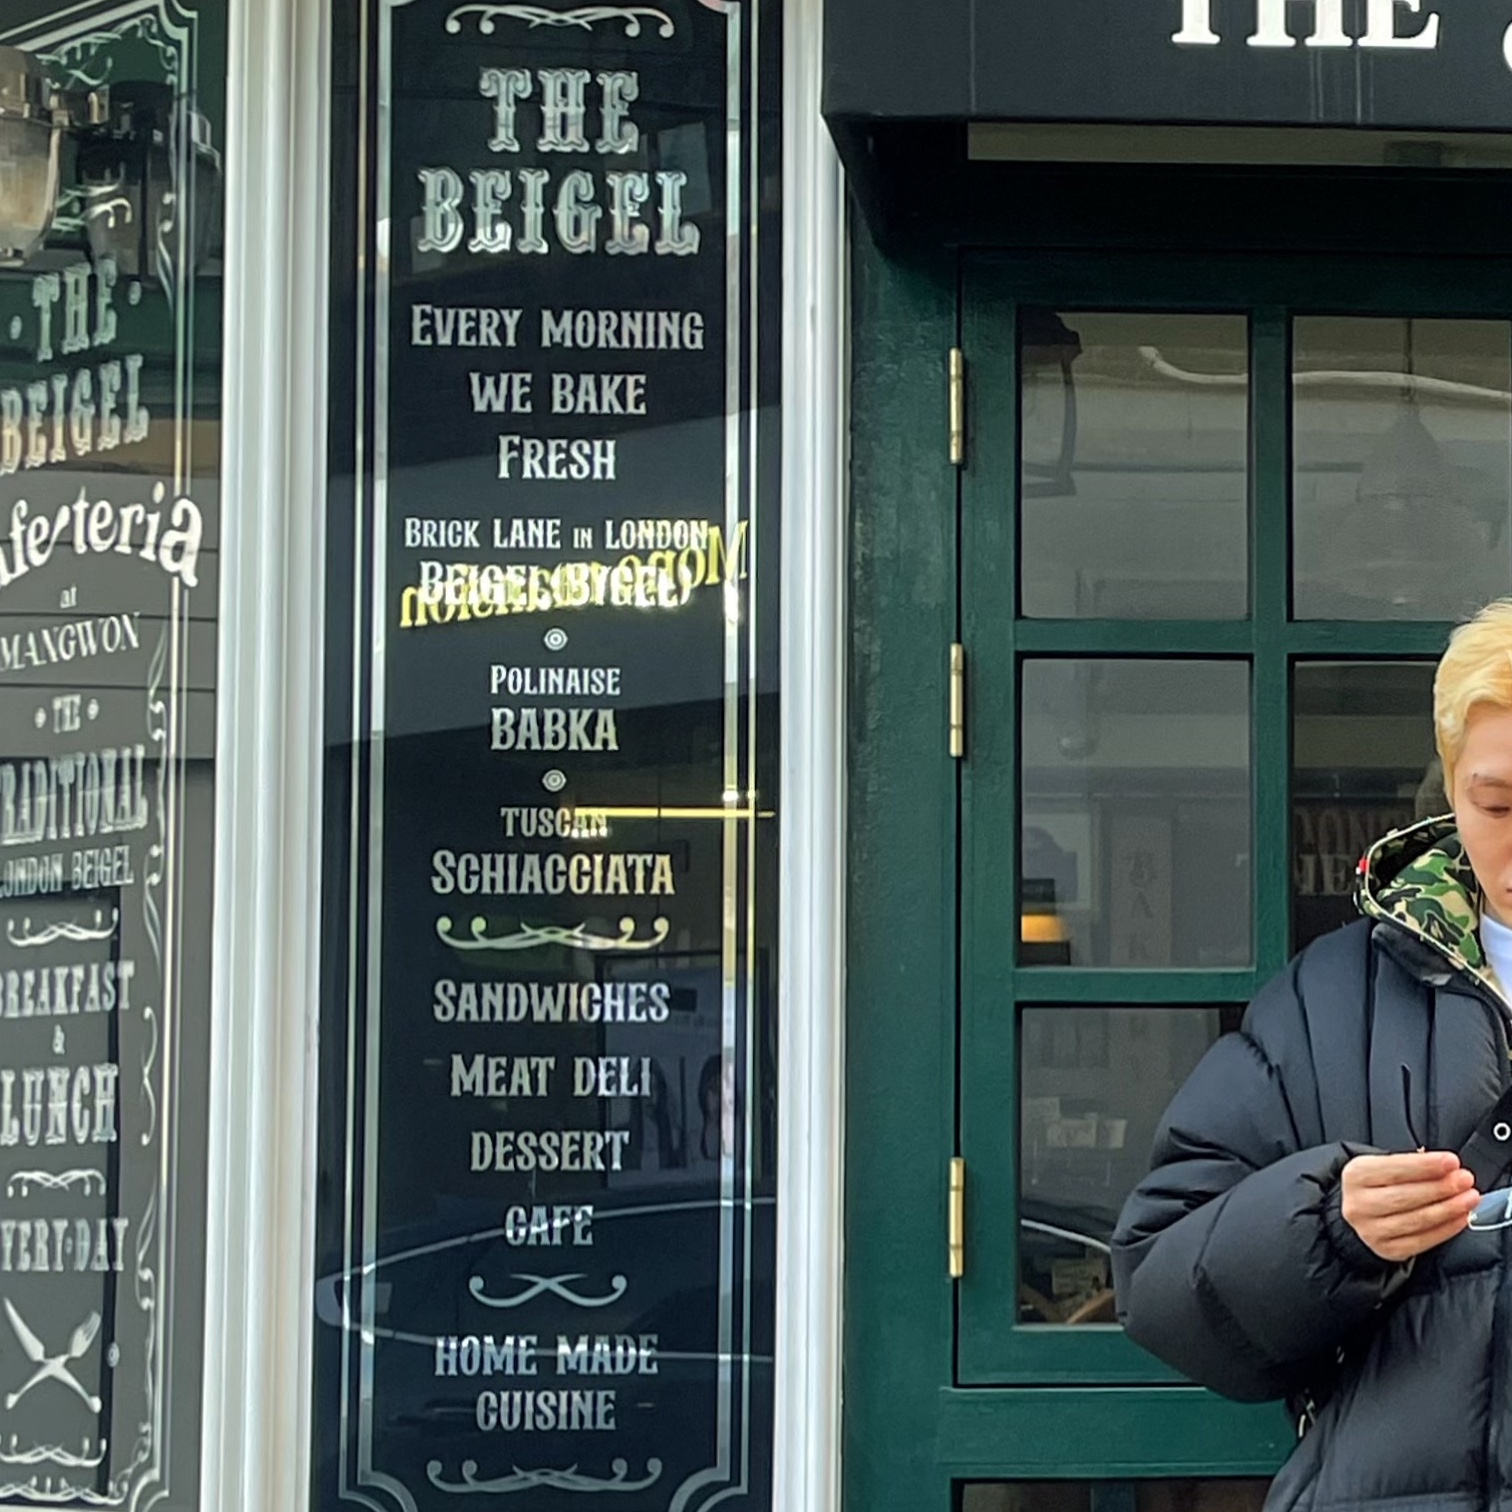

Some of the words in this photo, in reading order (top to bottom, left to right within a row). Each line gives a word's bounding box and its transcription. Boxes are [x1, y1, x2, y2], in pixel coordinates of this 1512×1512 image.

[479, 67, 639, 154] THE
[417, 166, 700, 255] BEIGEL
[32, 255, 117, 362] THE
[411, 304, 523, 347] EVERY
[541, 309, 704, 350] MORNING
[0, 354, 149, 477] BEIGEL
[469, 372, 532, 413] WE
[551, 373, 646, 415] BAKE
[498, 435, 616, 480] FRESH
[404, 517, 480, 548] BRICK
[493, 518, 561, 549] LANE
[605, 519, 709, 550] LONDON
[60, 584, 77, 608] at
[0, 611, 140, 671] MANGWON
[490, 665, 621, 695] POLINAISE
[490, 707, 619, 751] BABKA
[500, 807, 608, 837] TUSCAN
[71, 844, 134, 890] BEIGEL
[431, 849, 675, 895] SCHIACCIATA
[0, 960, 135, 1018] REAKFAST
[433, 979, 671, 1023] SANDWICHES
[53, 1024, 65, 1054] &
[451, 1054, 555, 1098] MEAT
[573, 1056, 651, 1098] DELI
[0, 1063, 118, 1146] LUNCH
[471, 1131, 629, 1172] DESSERT
[505, 1205, 593, 1246] CAFE
[435, 1335, 538, 1376] HOME
[556, 1334, 659, 1376] MADE
[476, 1390, 616, 1432] CUISINE
